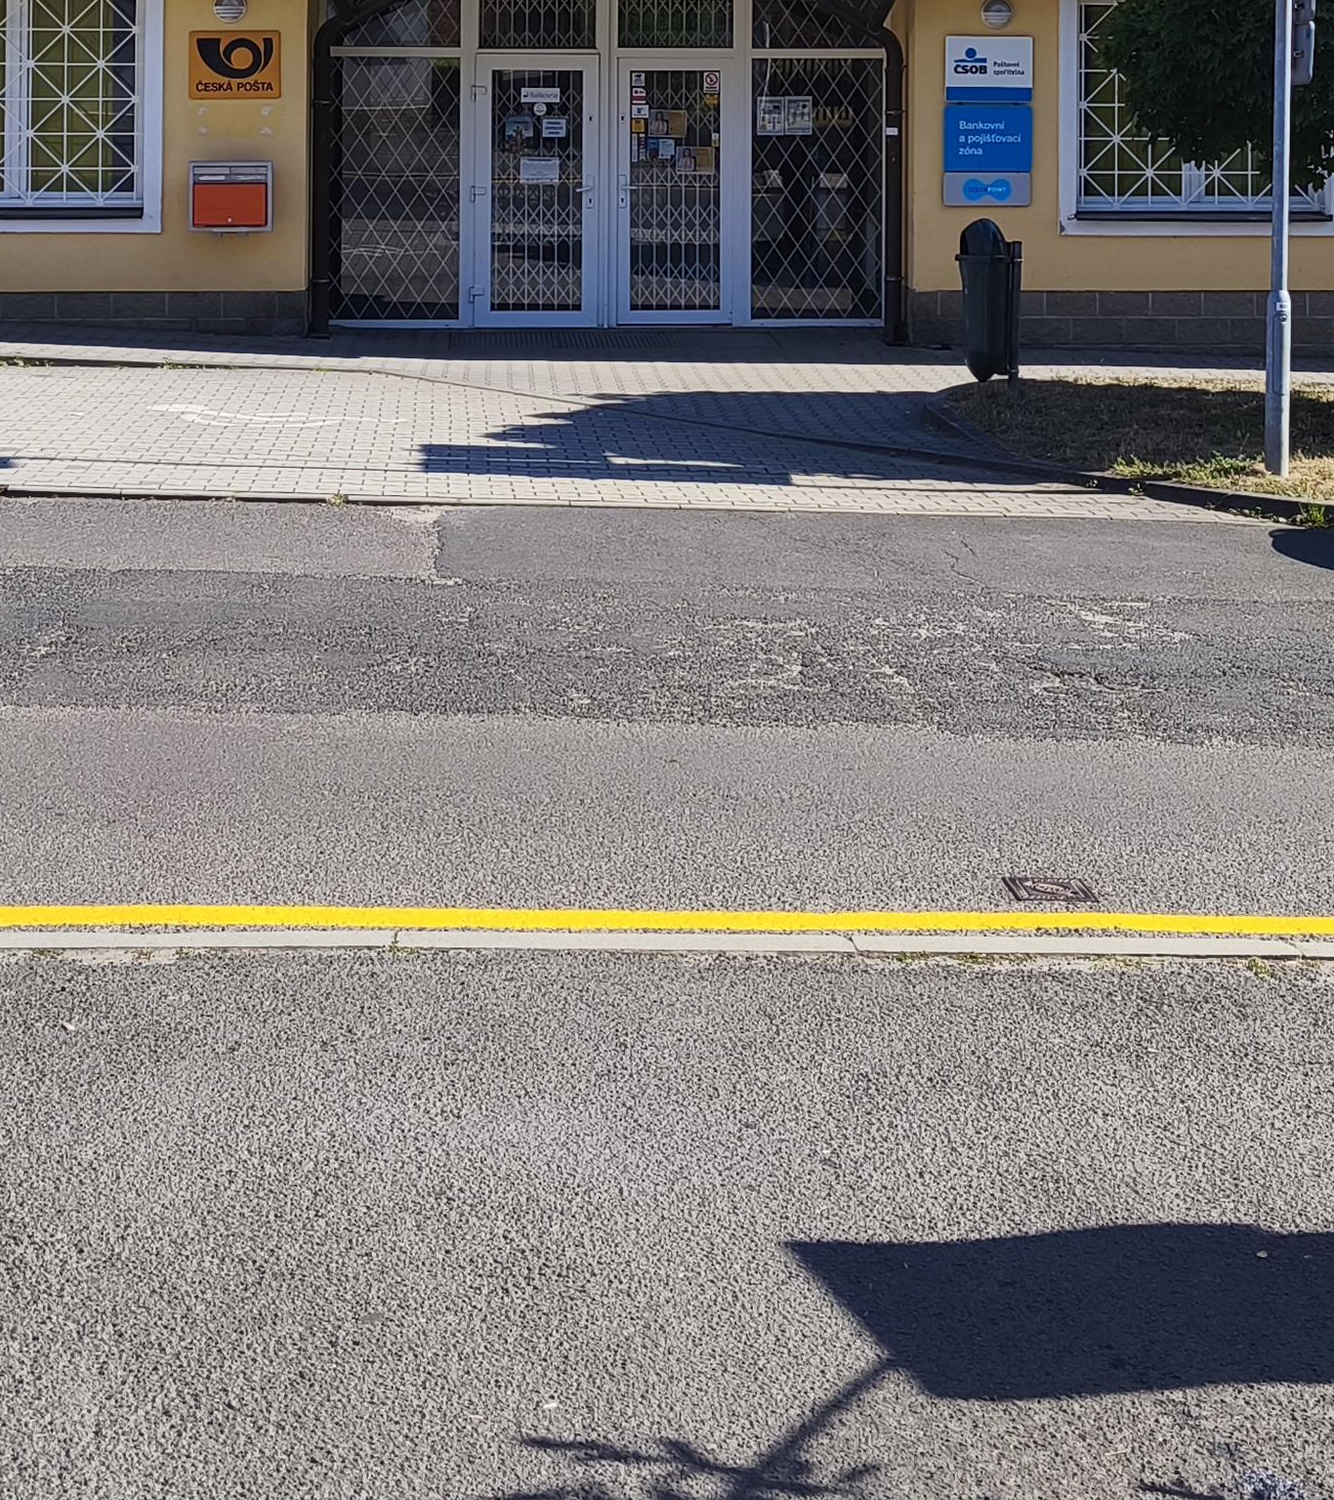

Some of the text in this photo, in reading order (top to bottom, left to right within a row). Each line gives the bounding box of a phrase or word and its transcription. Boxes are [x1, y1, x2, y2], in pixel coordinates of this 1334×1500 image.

[953, 63, 988, 75] ČSOB
[195, 80, 273, 92] ČESKÁ POŠTA
[958, 120, 1005, 130] Bankovní
[958, 133, 1022, 145] a pojišťovací
[958, 146, 983, 155] zóna
